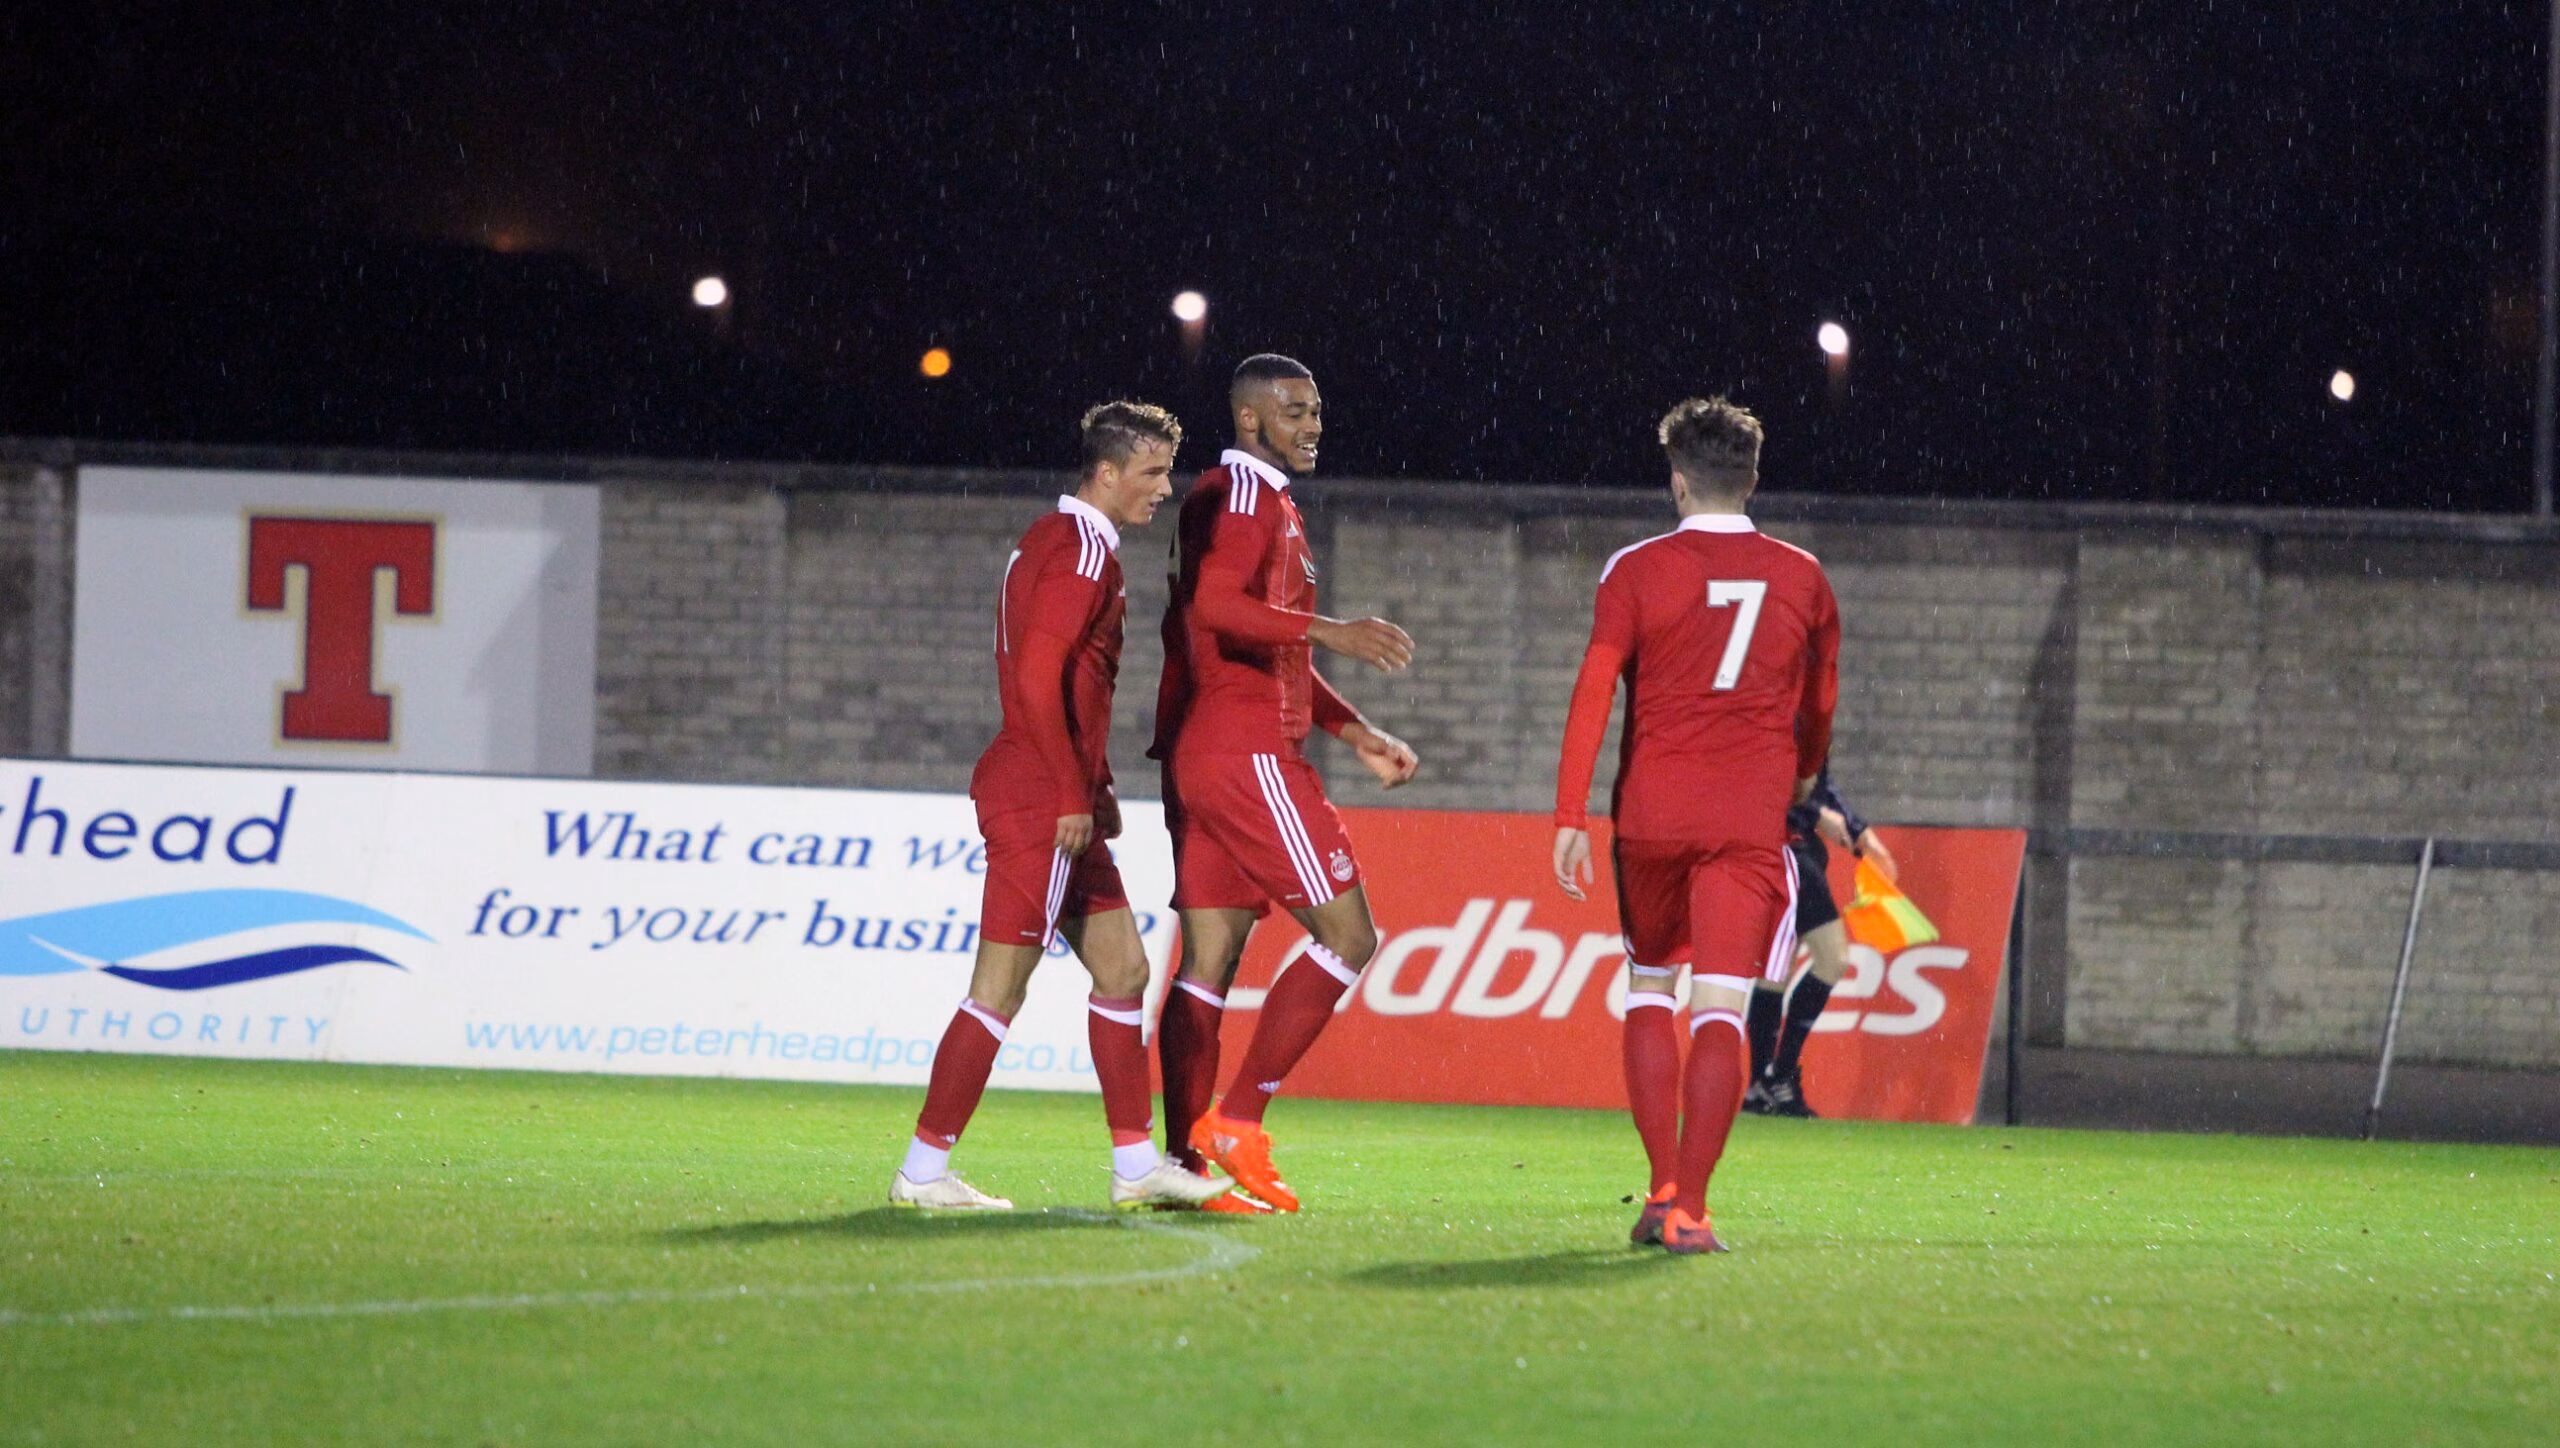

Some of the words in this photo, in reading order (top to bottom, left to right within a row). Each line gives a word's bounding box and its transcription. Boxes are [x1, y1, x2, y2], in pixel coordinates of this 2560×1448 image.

[243, 513, 440, 747] T
[1706, 579, 1768, 690] 7
[0, 776, 296, 865] head
[543, 809, 728, 863] What
[748, 830, 872, 869] can
[466, 886, 580, 938] for
[590, 904, 787, 951] your
[0, 1006, 330, 1045] UTHORITY
